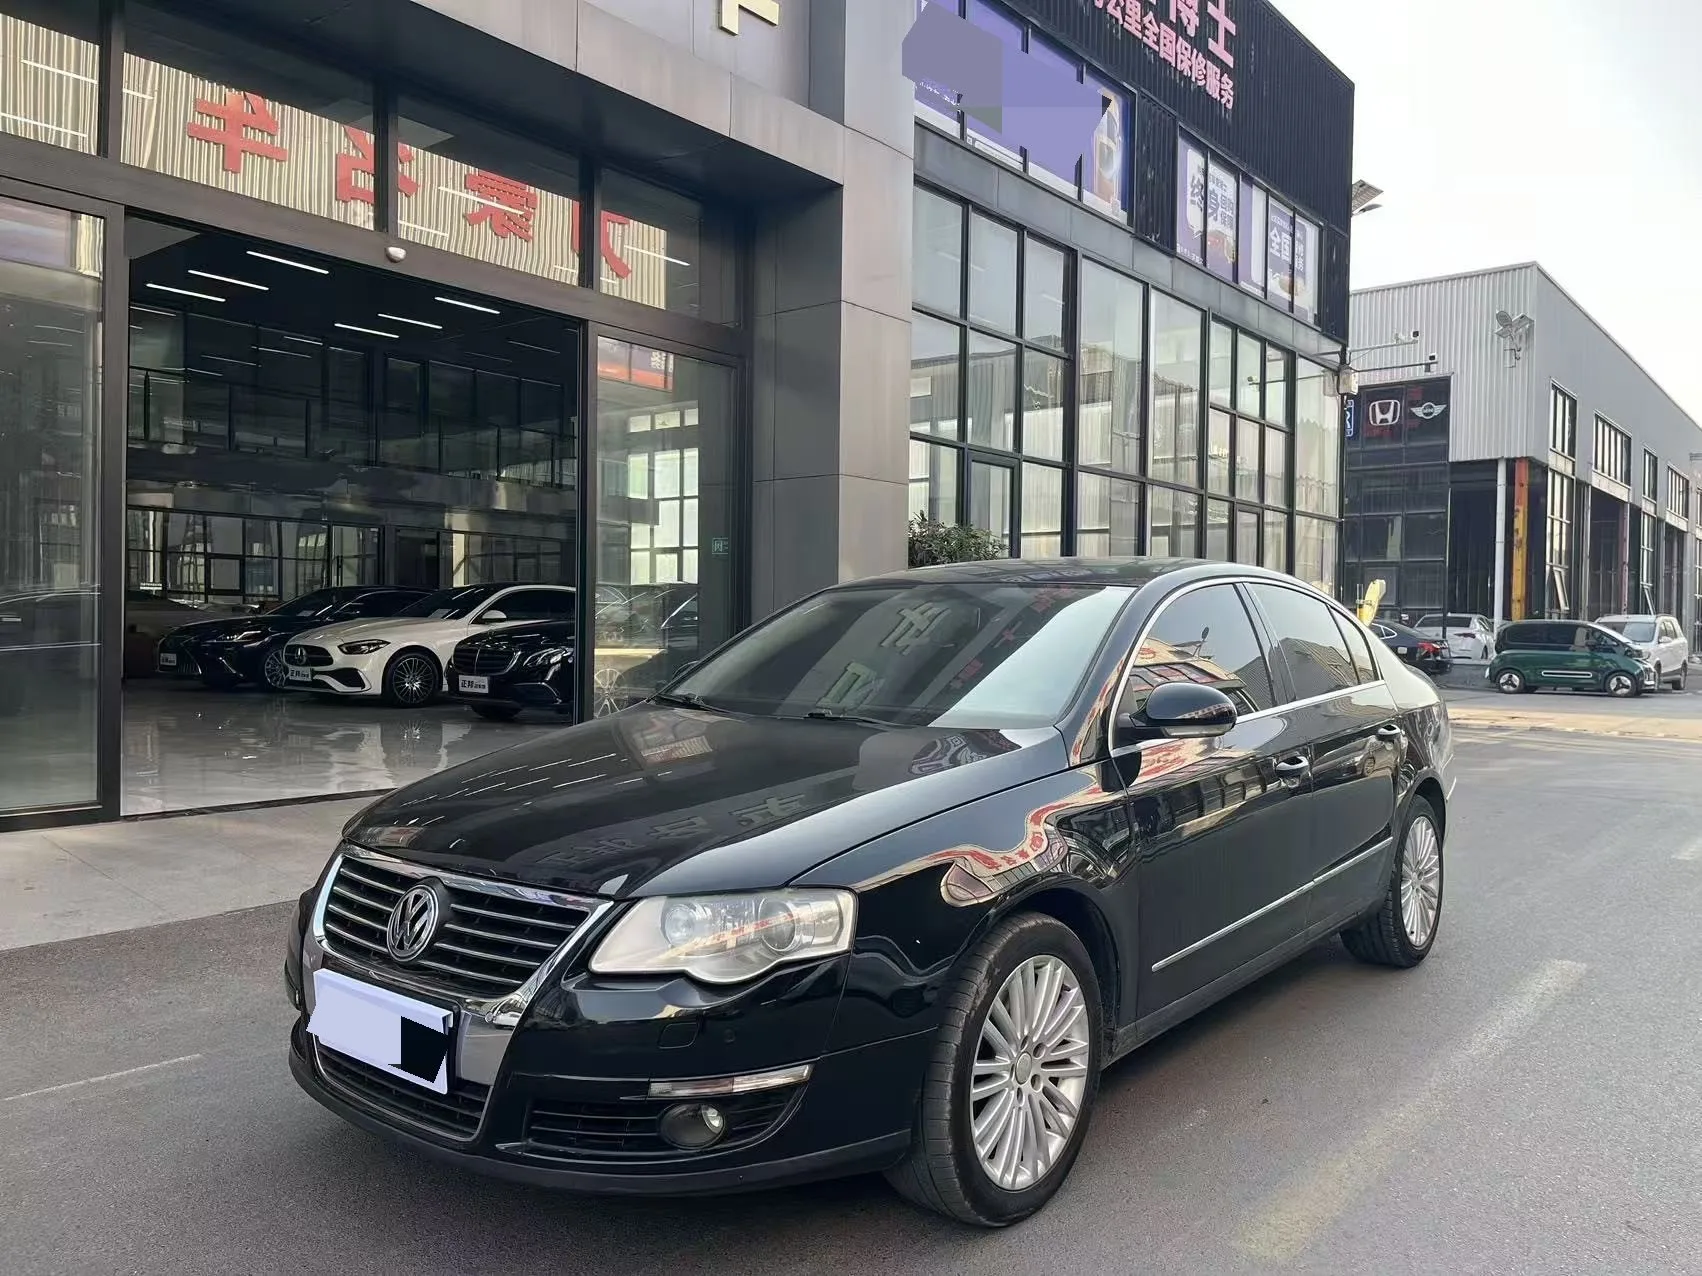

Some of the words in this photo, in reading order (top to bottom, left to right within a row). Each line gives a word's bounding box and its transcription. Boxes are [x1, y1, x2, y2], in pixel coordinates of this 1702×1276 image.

[1094, 0, 1234, 109] 公里全国保修服务
